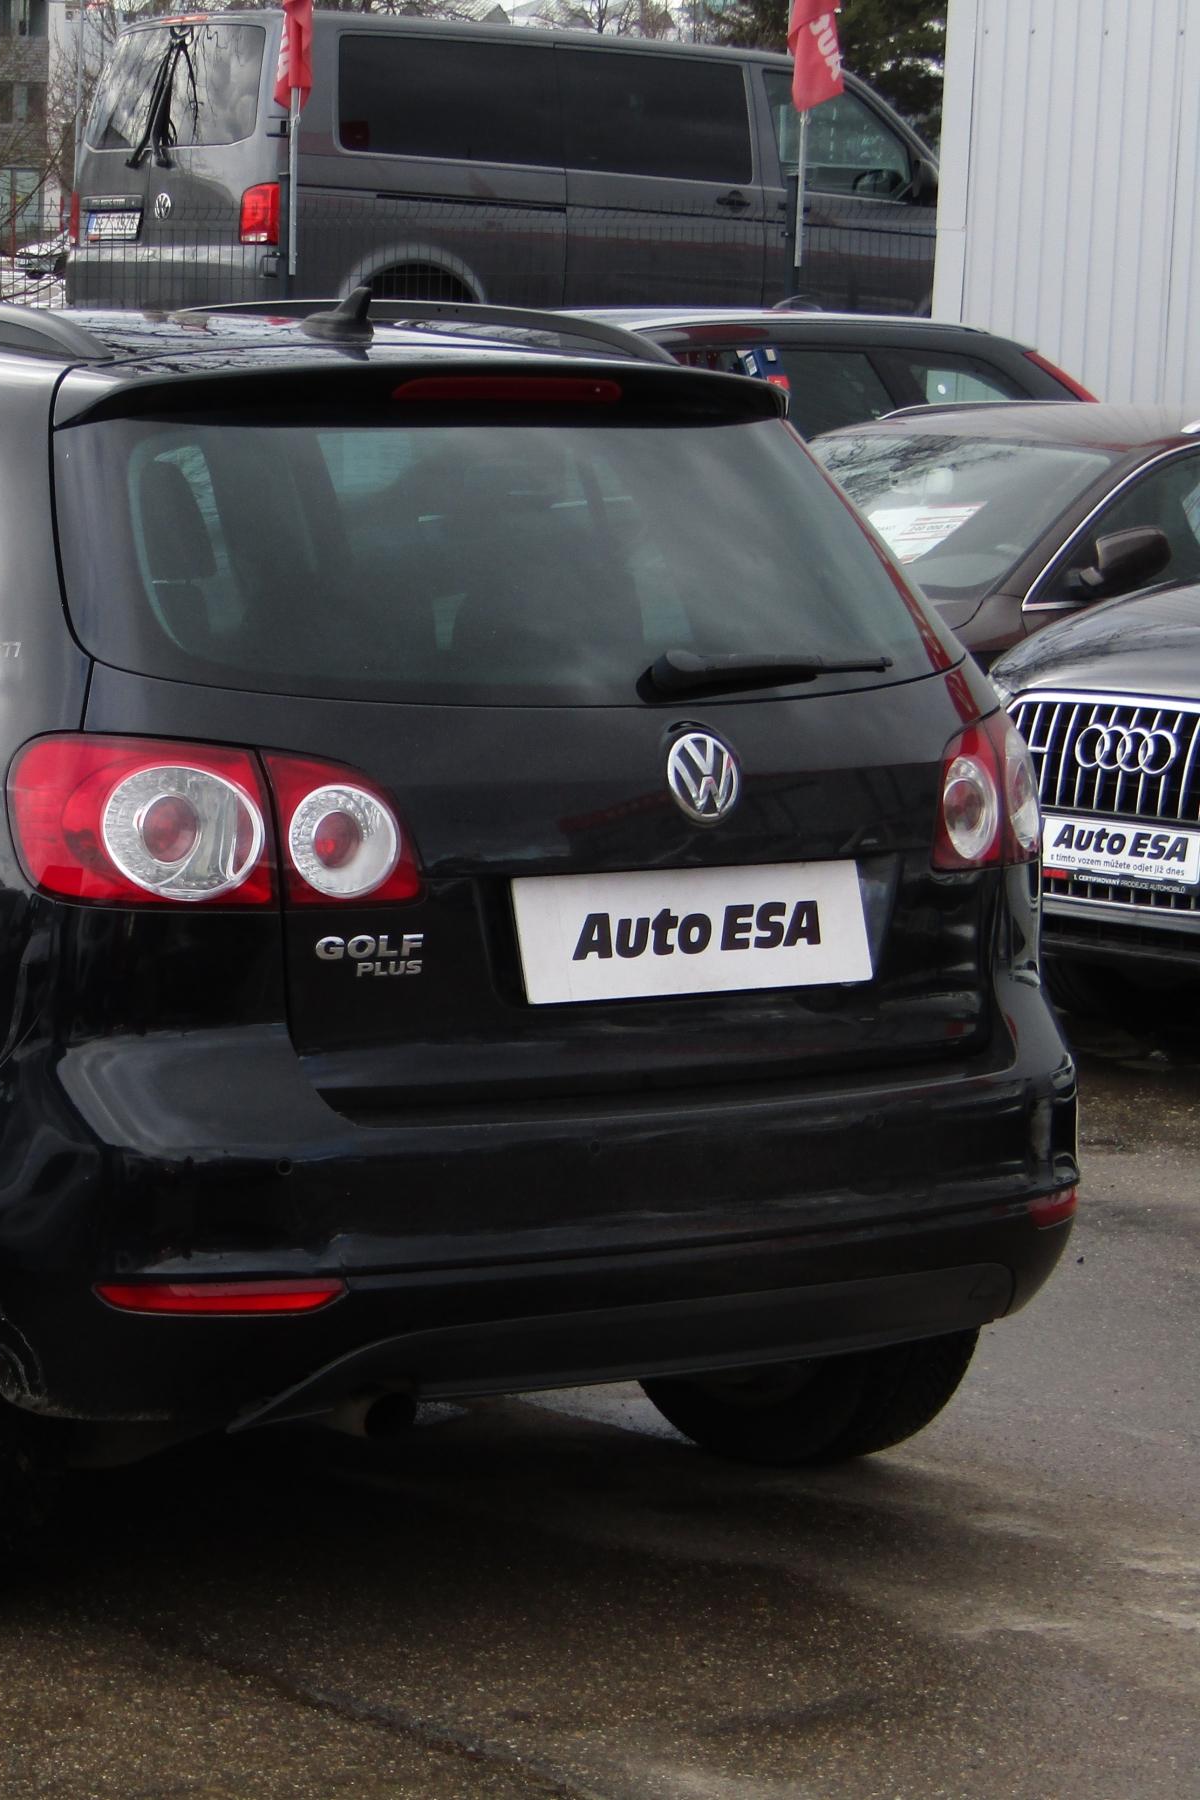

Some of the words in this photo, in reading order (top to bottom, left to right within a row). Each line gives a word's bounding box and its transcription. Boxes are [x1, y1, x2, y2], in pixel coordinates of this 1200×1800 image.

[668, 732, 739, 828] VW
[1052, 823, 1126, 856] Auto
[1128, 832, 1189, 862] ESA
[1078, 857, 1101, 866] vozem
[1132, 863, 1152, 872] odjet
[1166, 867, 1185, 876] dnes
[315, 933, 424, 960] GOLF
[572, 908, 712, 961] Auto
[720, 900, 821, 951] ESA
[356, 960, 422, 977] PLUS
